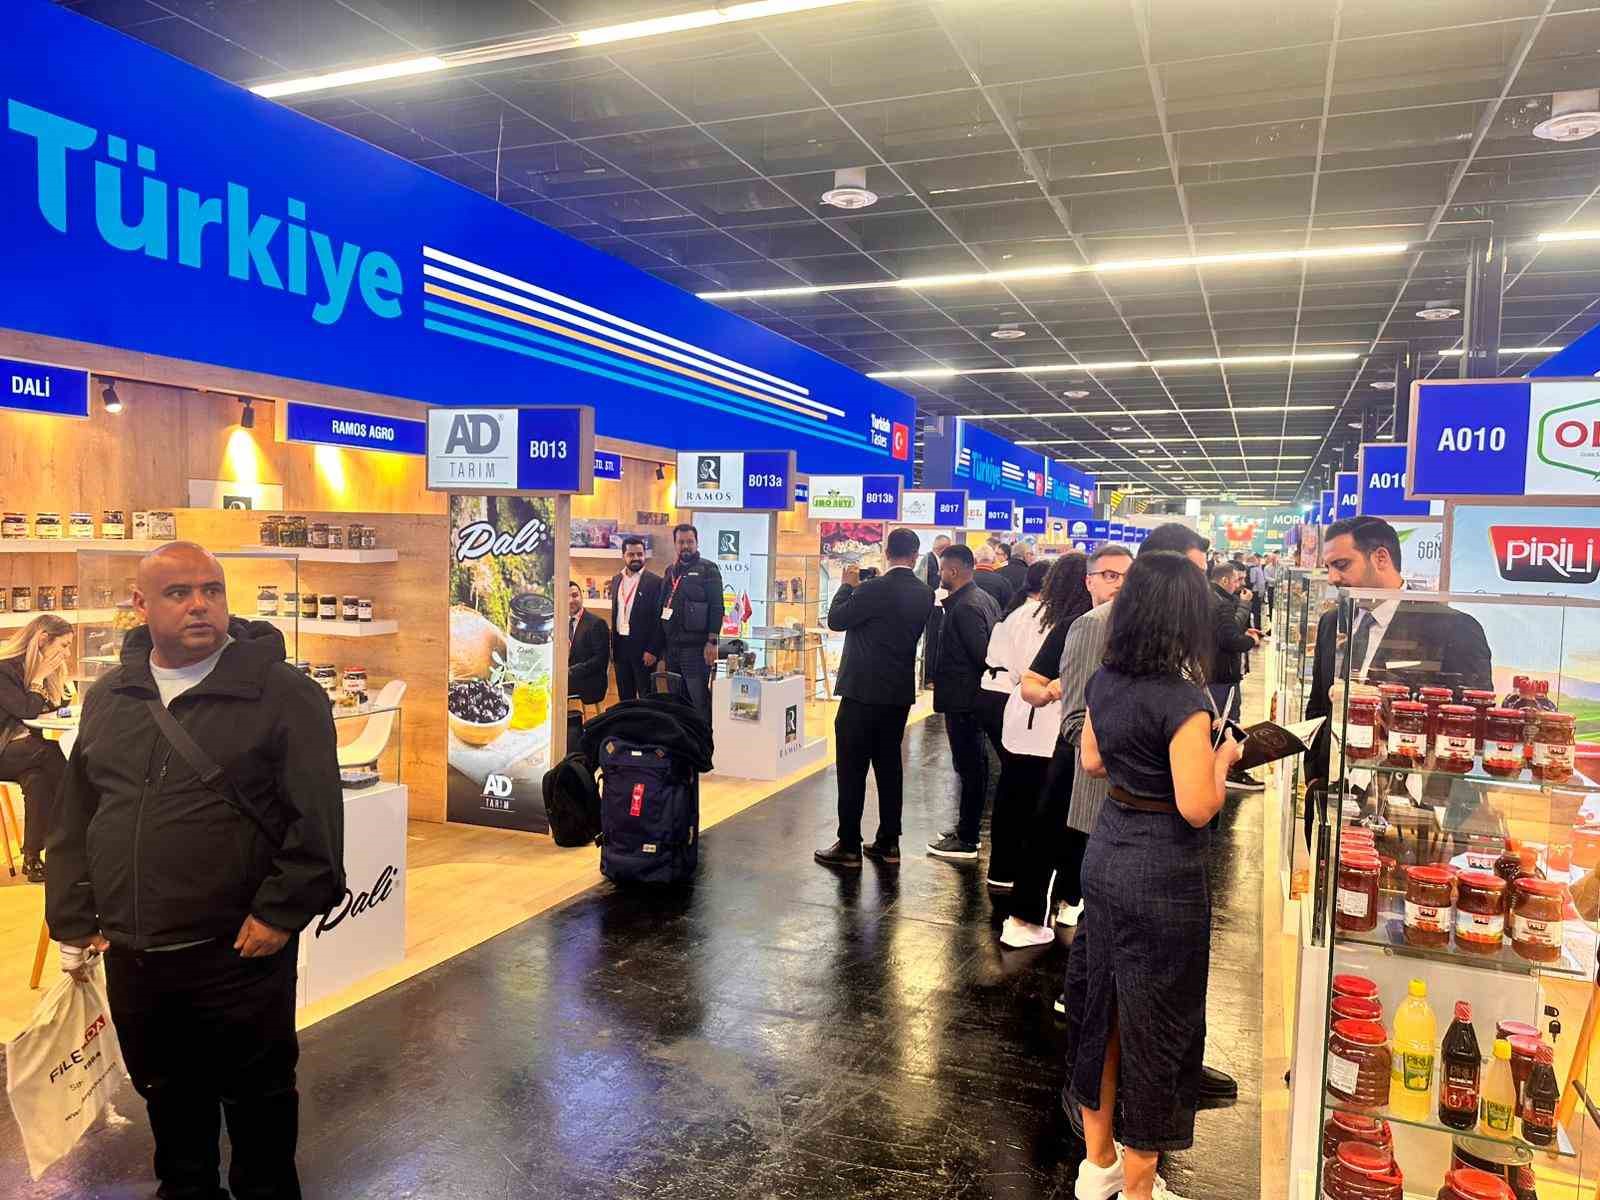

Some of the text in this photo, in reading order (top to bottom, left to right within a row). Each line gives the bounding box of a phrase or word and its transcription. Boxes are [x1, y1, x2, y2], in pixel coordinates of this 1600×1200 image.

[8, 98, 404, 326] Türkiye
[331, 420, 395, 442] RAMOS AGRO
[444, 413, 501, 455] AD
[1437, 426, 1506, 452] A010
[529, 440, 567, 459] B013
[450, 462, 496, 478] TARIM
[748, 474, 782, 488] B013a
[686, 492, 732, 502] RAMOS
[483, 774, 513, 797] AD
[486, 799, 510, 809] TARIM
